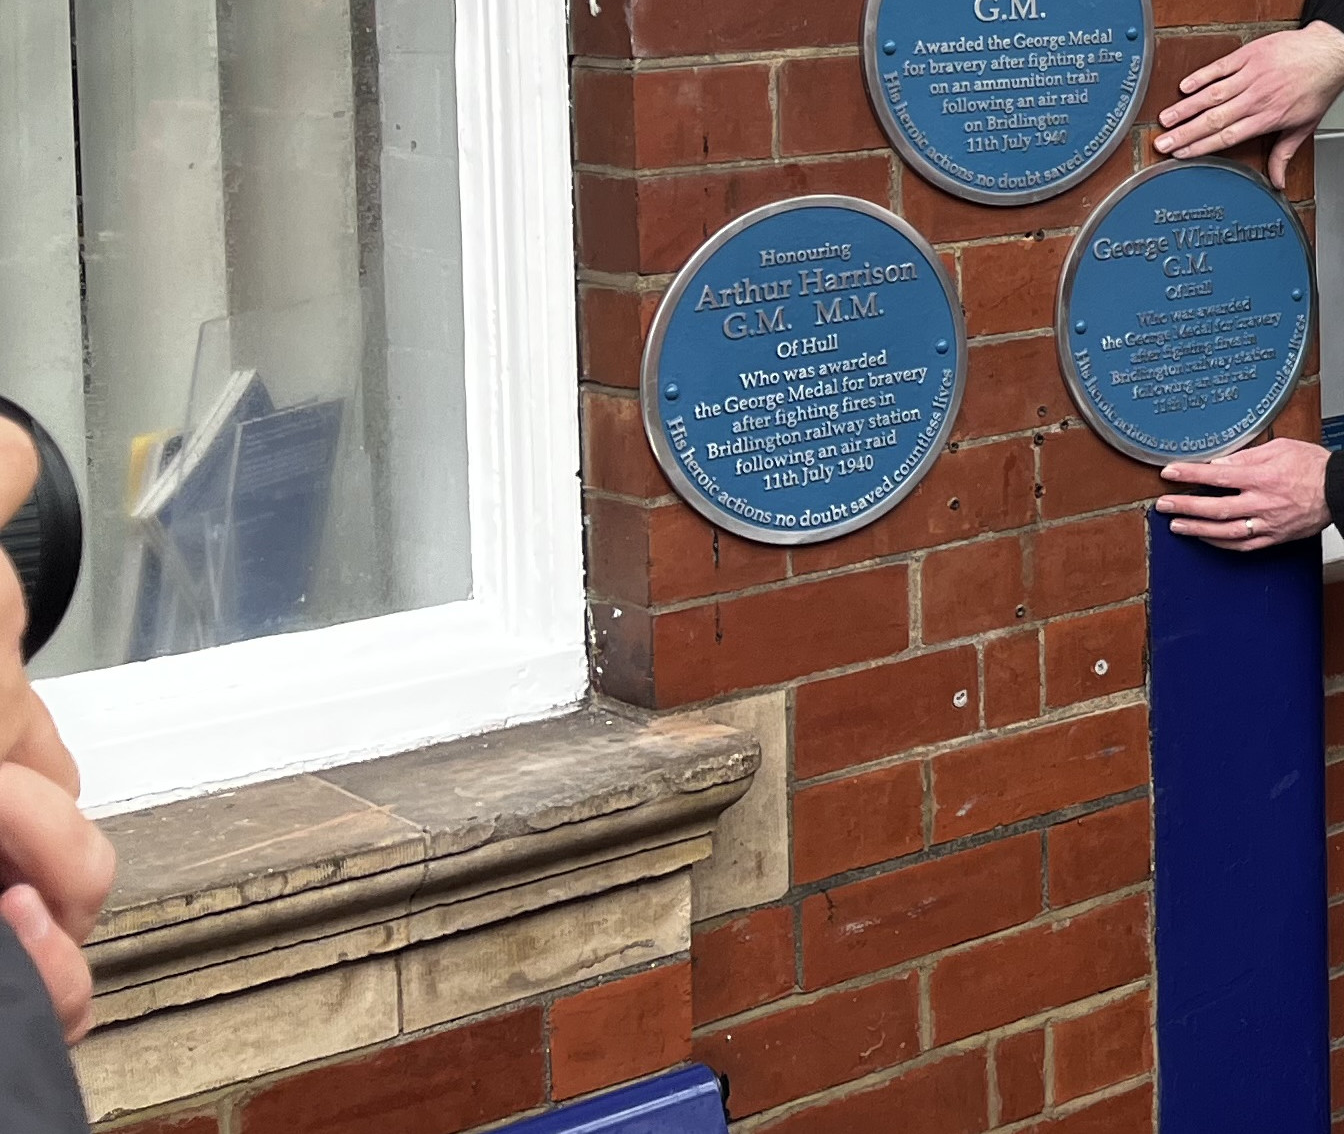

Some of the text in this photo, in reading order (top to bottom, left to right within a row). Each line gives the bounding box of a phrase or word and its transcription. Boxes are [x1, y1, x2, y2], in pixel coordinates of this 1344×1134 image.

[914, 29, 1113, 55] Awarded the George Medal
[964, 112, 1069, 133] on Bridlington
[967, 136, 998, 153] 11th
[1001, 134, 1032, 152] July
[759, 242, 852, 268] Honouring
[1093, 235, 1169, 261] George
[1163, 251, 1213, 278] G.M.
[694, 260, 918, 312] Arthur Harrison
[723, 292, 885, 340] G.M. M.M.
[776, 334, 839, 359] Of Hull
[739, 350, 888, 390] Who was awarded
[694, 366, 928, 420] the George Medal for bravery
[731, 391, 896, 435] after fighting fires in
[706, 406, 921, 460] Bridlington railway station
[763, 454, 874, 491] 11th July 1940
